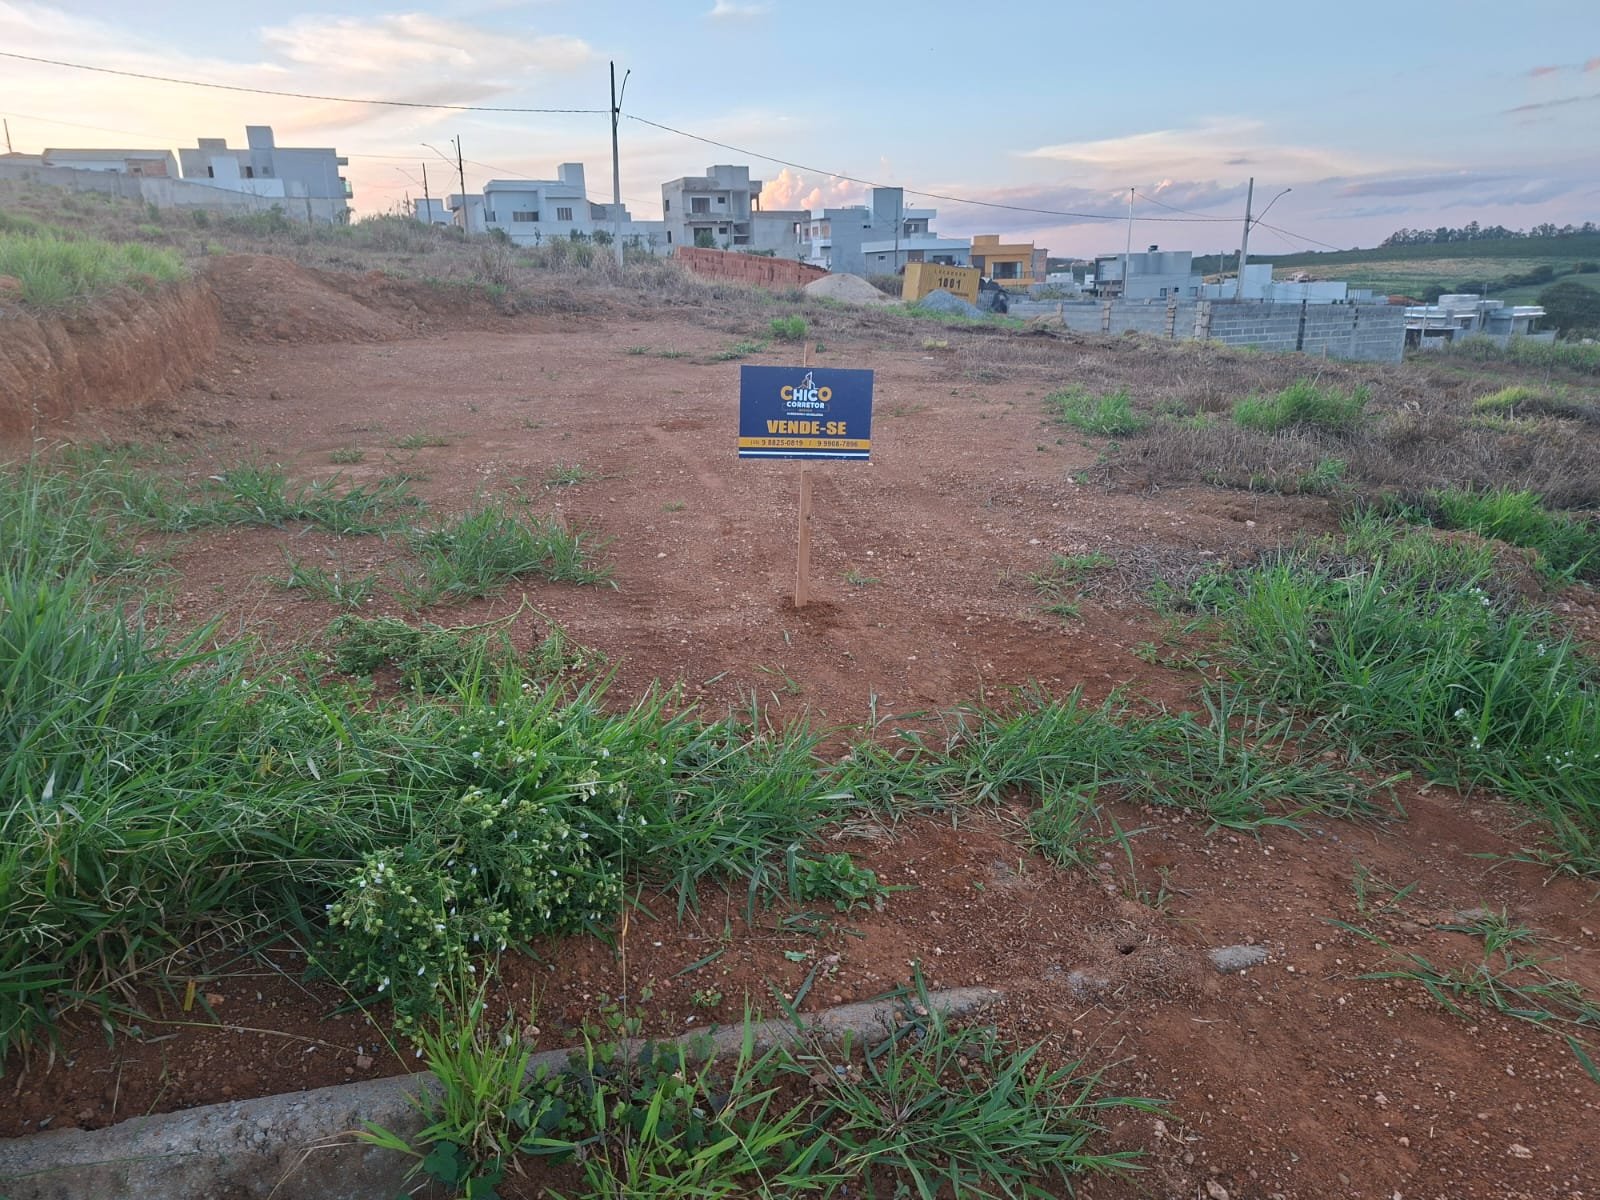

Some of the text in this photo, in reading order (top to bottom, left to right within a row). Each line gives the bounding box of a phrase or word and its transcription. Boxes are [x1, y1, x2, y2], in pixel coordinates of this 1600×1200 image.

[938, 277, 961, 289] 1001
[780, 385, 832, 402] CHICO
[786, 401, 825, 409] CORRETOR
[766, 420, 847, 435] VENDE-SE
